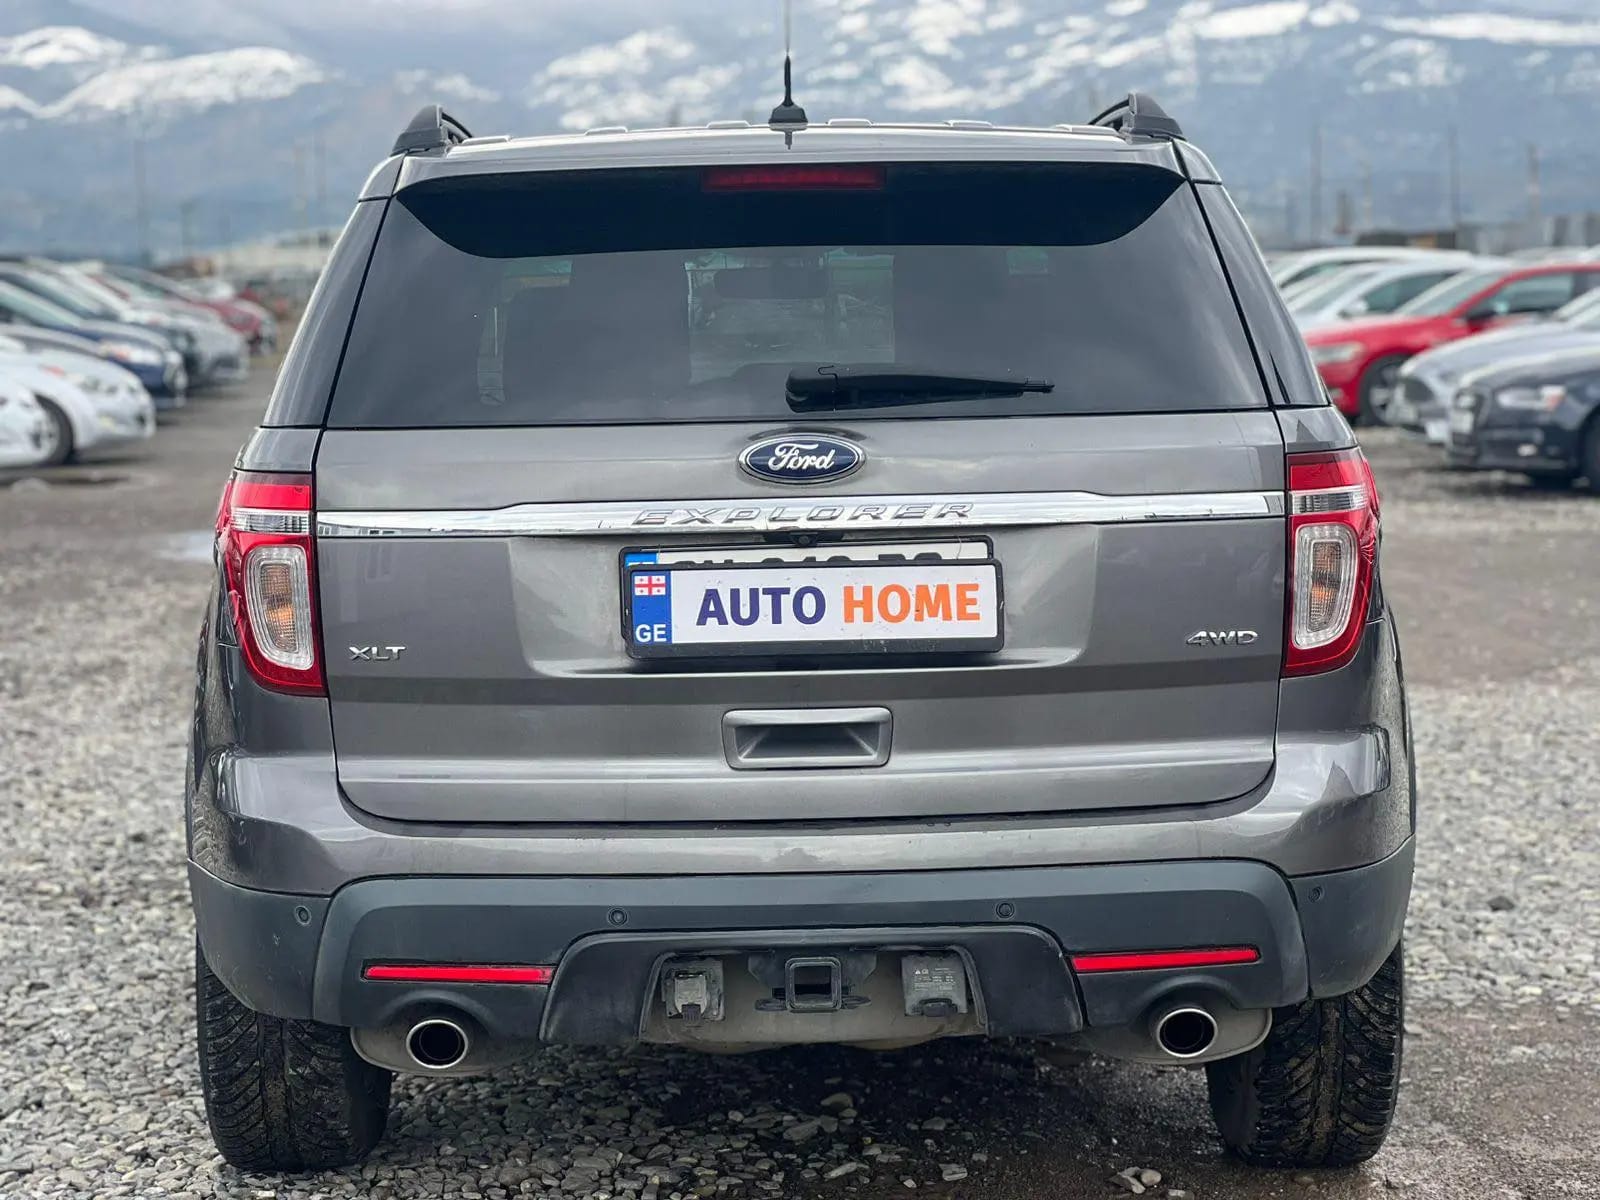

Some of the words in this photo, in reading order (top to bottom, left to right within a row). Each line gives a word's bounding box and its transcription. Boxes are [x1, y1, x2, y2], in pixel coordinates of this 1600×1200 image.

[768, 443, 835, 471] Ford
[632, 501, 974, 526] EXPLORER
[696, 585, 826, 626] AUTO
[843, 583, 980, 623] HOME
[635, 624, 667, 643] GE
[1186, 630, 1258, 646] 4WD
[349, 646, 406, 661] XLT
